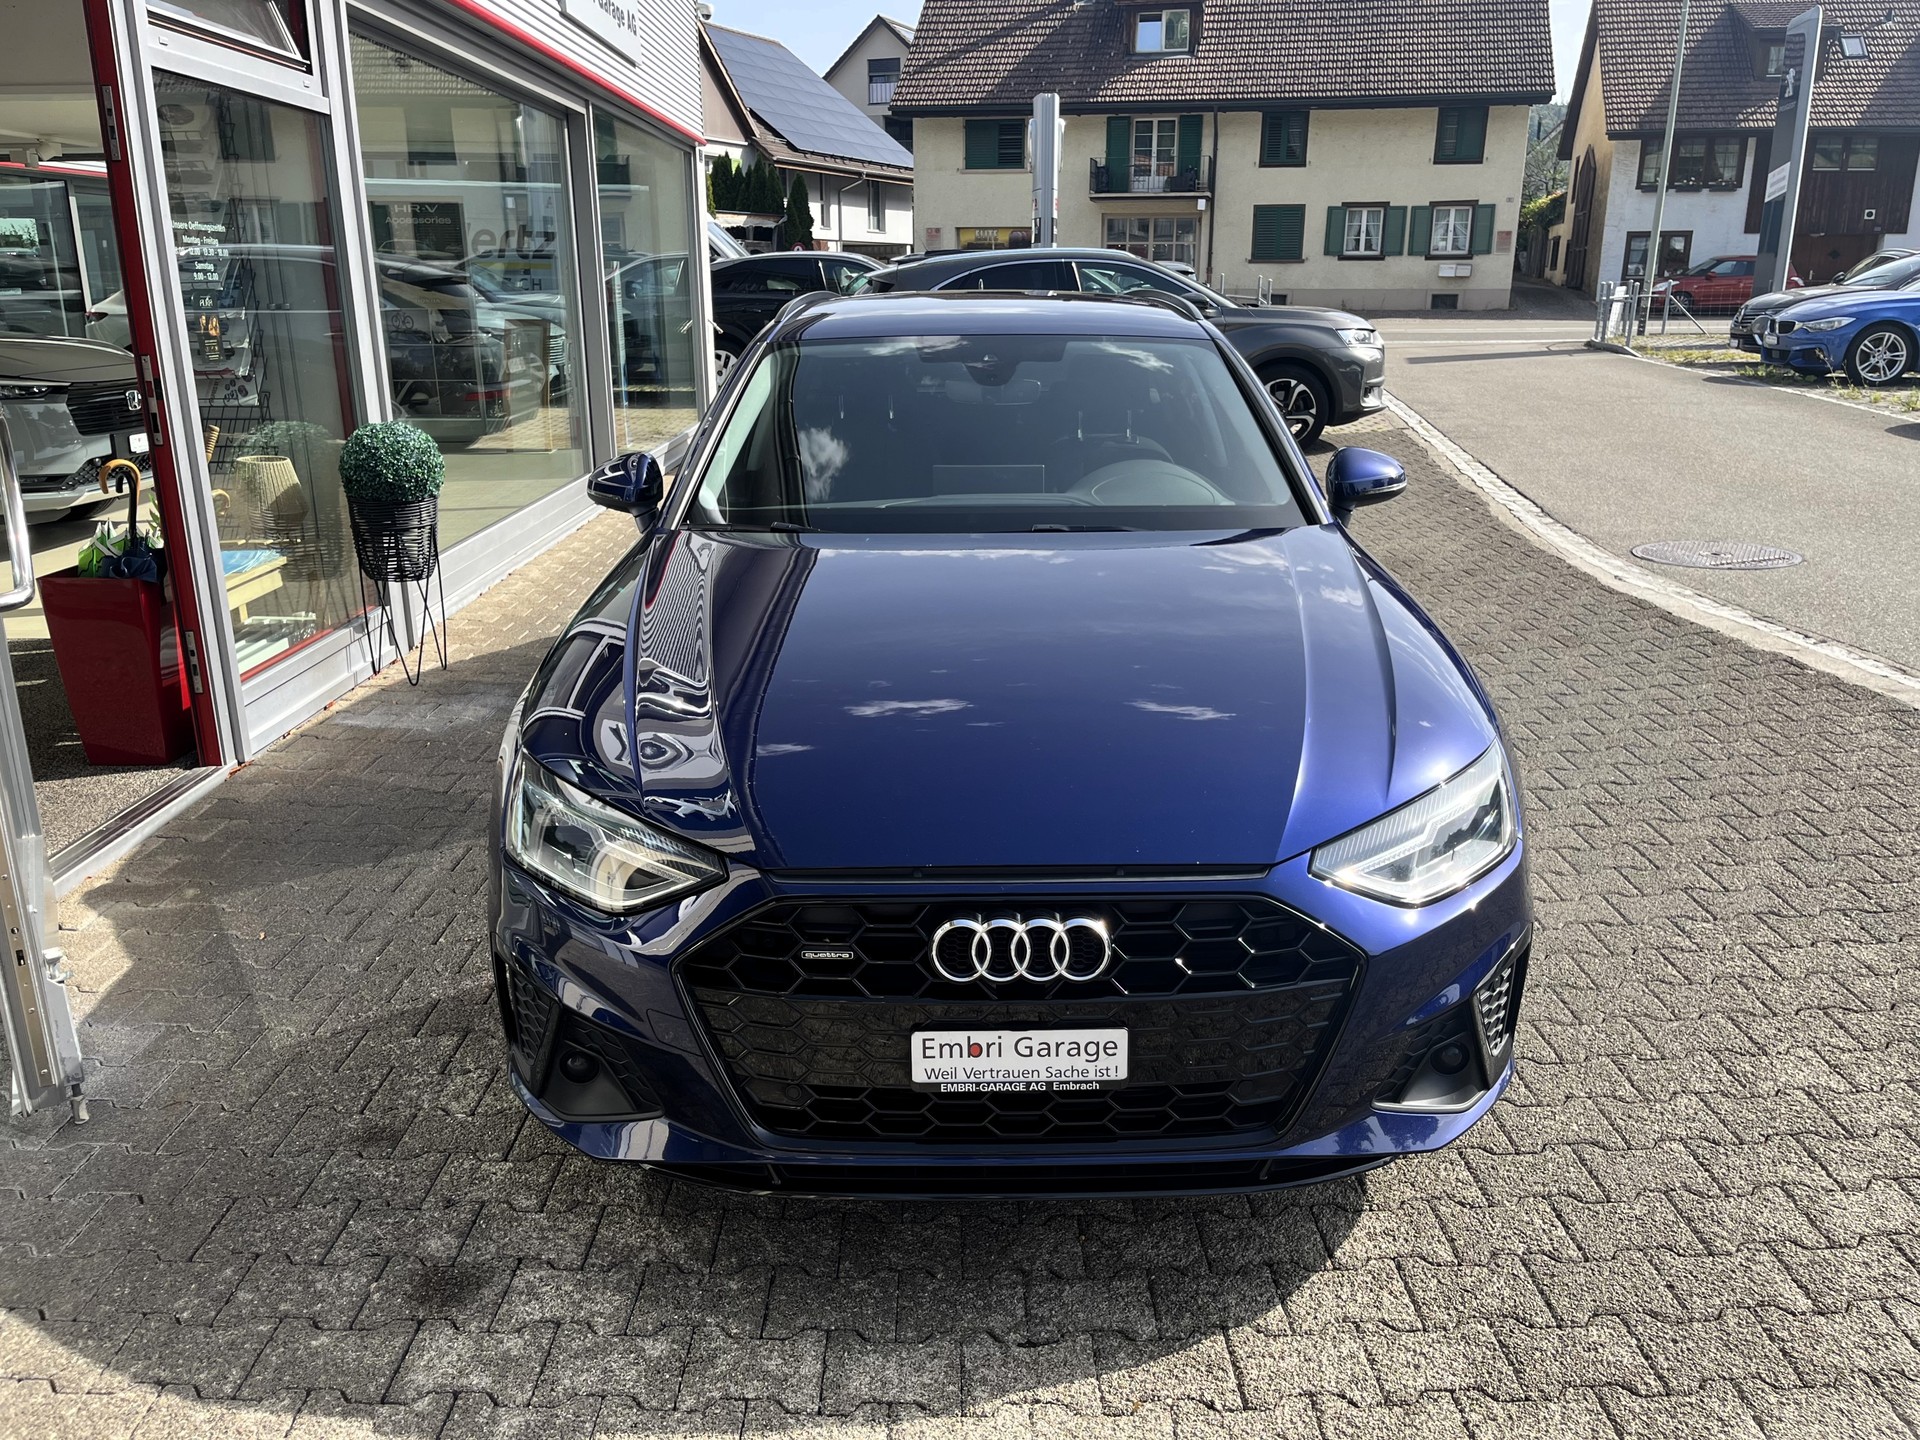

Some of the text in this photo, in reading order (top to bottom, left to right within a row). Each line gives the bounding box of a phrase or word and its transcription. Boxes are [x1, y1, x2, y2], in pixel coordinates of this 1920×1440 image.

[627, 9, 637, 36] AG
[394, 204, 439, 213] HR-V
[385, 216, 452, 225] Accessories
[182, 235, 201, 246] Montag
[203, 236, 219, 247] Freitag
[467, 222, 557, 259] ertz
[195, 261, 215, 272] Samstag
[922, 1035, 1119, 1063] Embri Garage
[924, 1067, 958, 1081] Weil
[962, 1066, 1041, 1080] Vertrauen
[1045, 1065, 1090, 1079] Sache
[940, 1081, 1100, 1093] EMBRI-GARAGE AG Embrach
